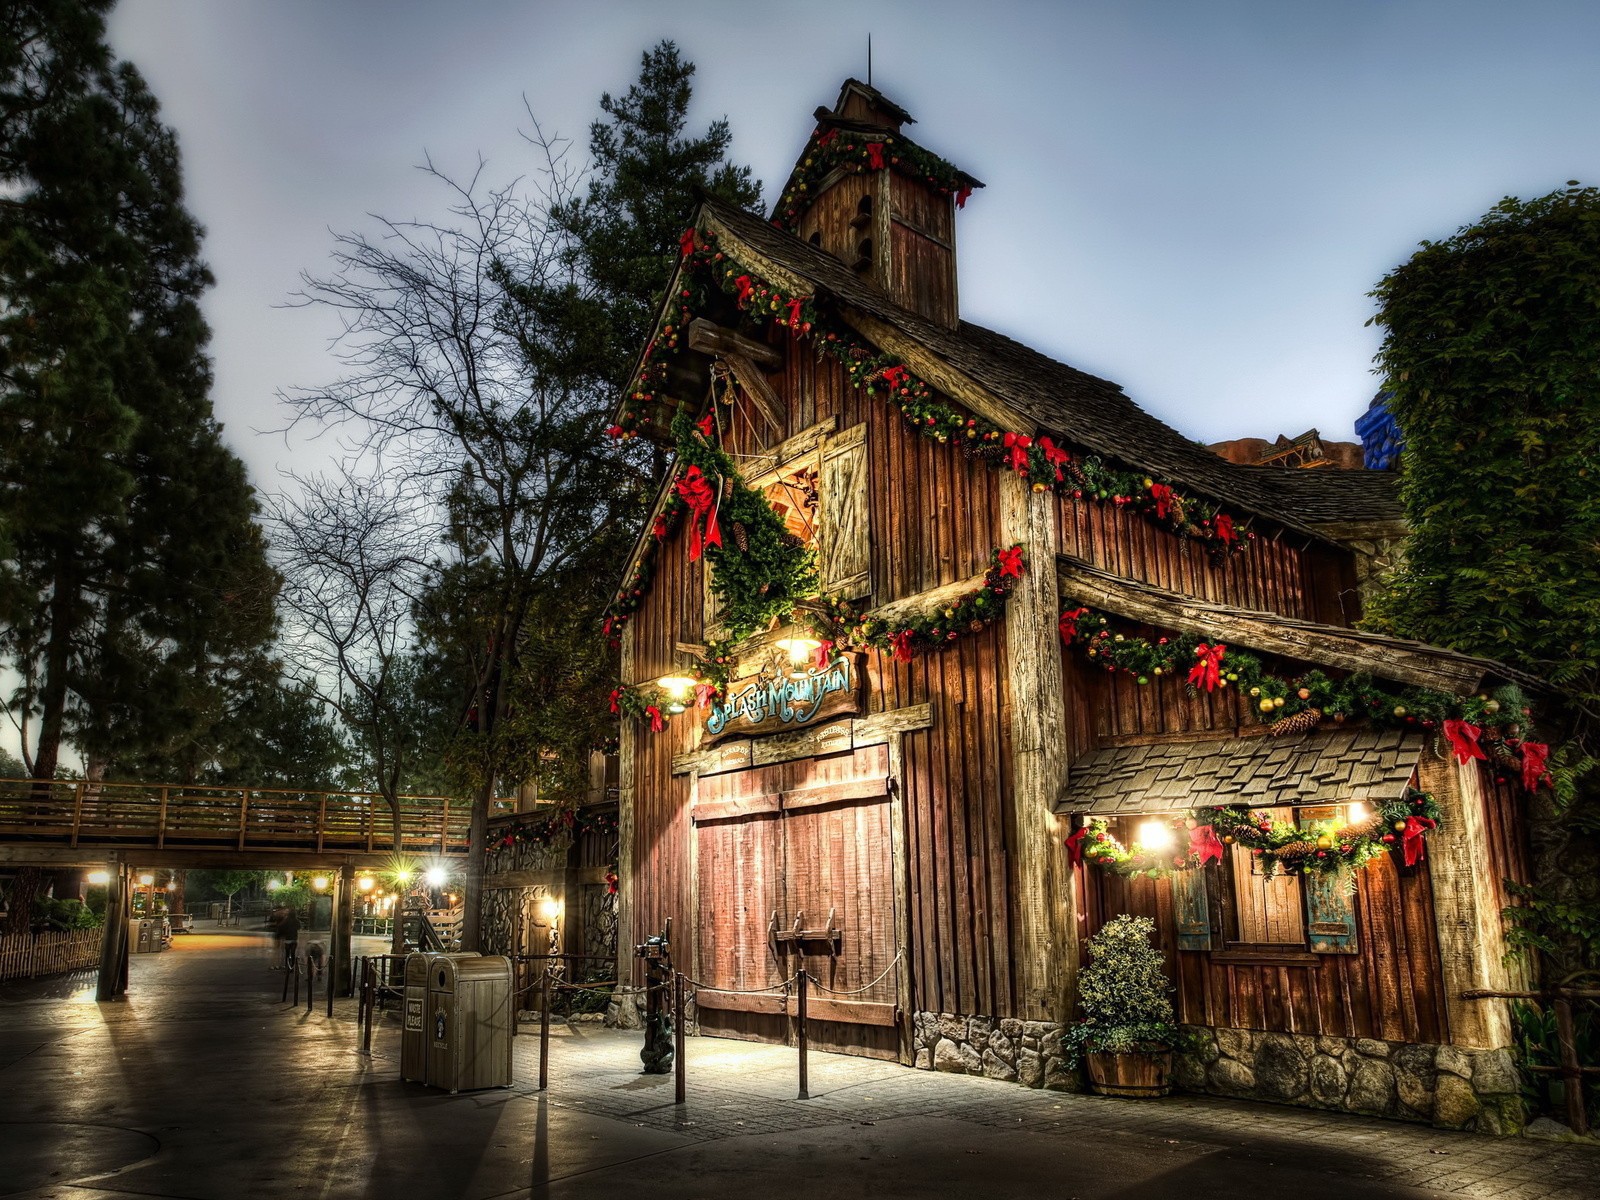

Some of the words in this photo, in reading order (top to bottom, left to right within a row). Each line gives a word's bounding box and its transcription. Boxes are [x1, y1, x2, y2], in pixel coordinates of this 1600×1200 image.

[707, 683, 768, 734] SPLASH
[768, 656, 849, 722] MOUNTAIN
[408, 1015, 421, 1026] PLEASE
